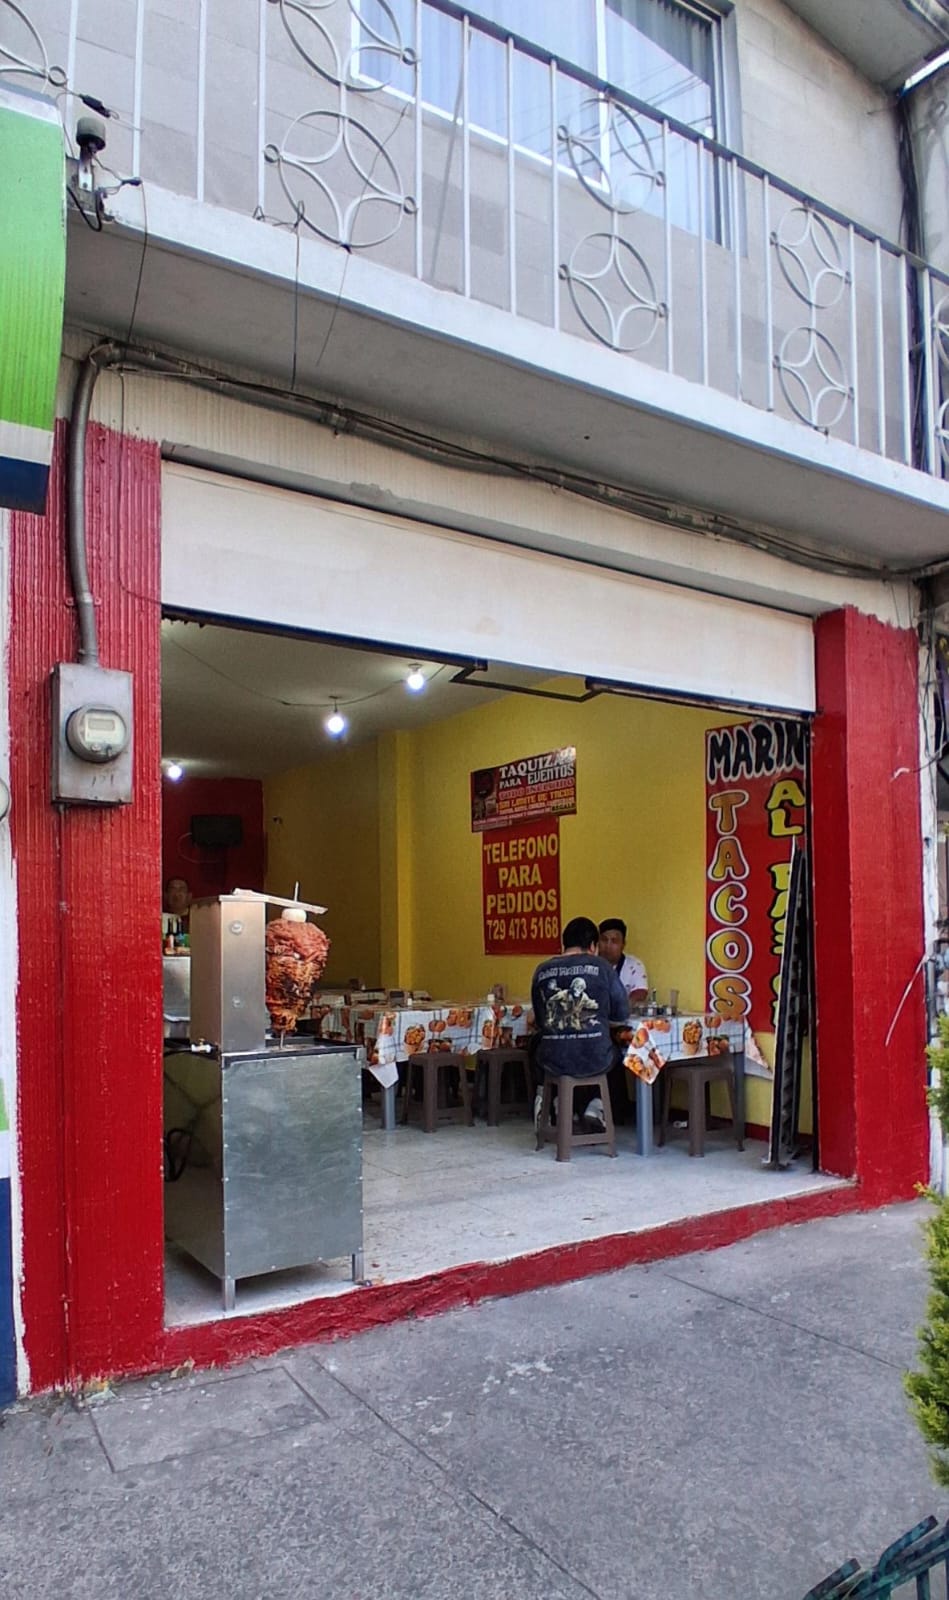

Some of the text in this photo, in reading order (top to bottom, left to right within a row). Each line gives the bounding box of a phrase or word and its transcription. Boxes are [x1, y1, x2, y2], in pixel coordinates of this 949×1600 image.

[499, 750, 574, 778] TAQUIZA
[499, 763, 574, 789] PARA EVENTOS
[767, 779, 806, 837] AL
[483, 833, 559, 865] TELEFONO
[498, 863, 542, 888] PARA
[486, 888, 558, 915] PEDIDOS
[705, 789, 752, 1021] TACOS
[486, 915, 559, 941] 729 473 5168
